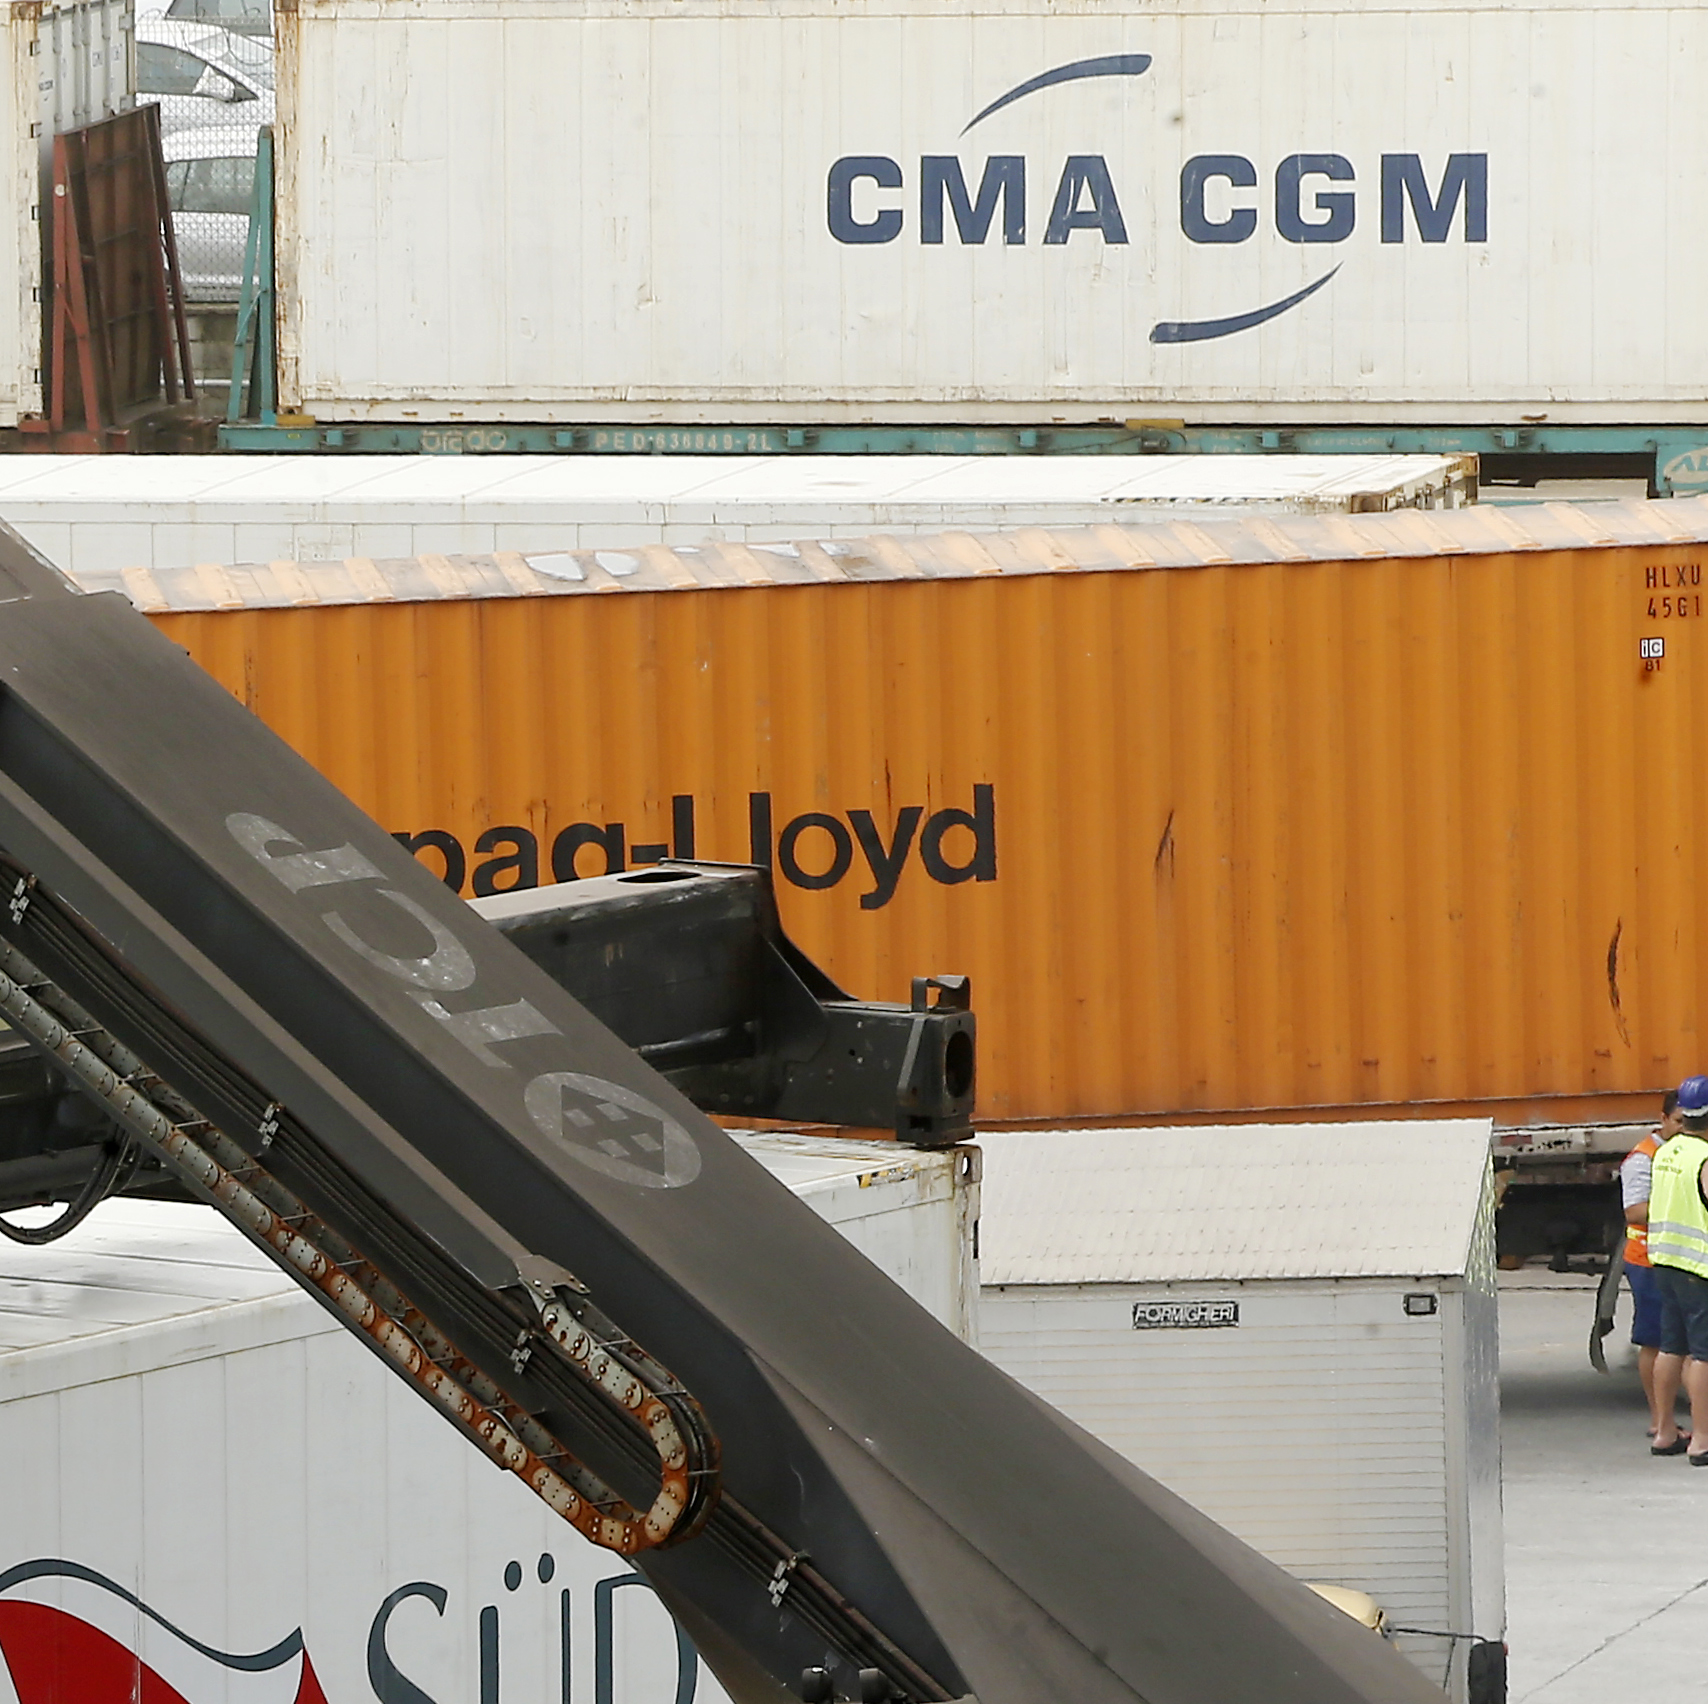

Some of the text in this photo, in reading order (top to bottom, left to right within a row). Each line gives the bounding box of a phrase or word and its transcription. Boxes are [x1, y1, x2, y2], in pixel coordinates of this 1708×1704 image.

[827, 153, 1489, 246] CMA CGM
[1646, 564, 1700, 588] HLXU
[1647, 595, 1700, 618] 45G1
[391, 783, 997, 910] pag-Lloyd
